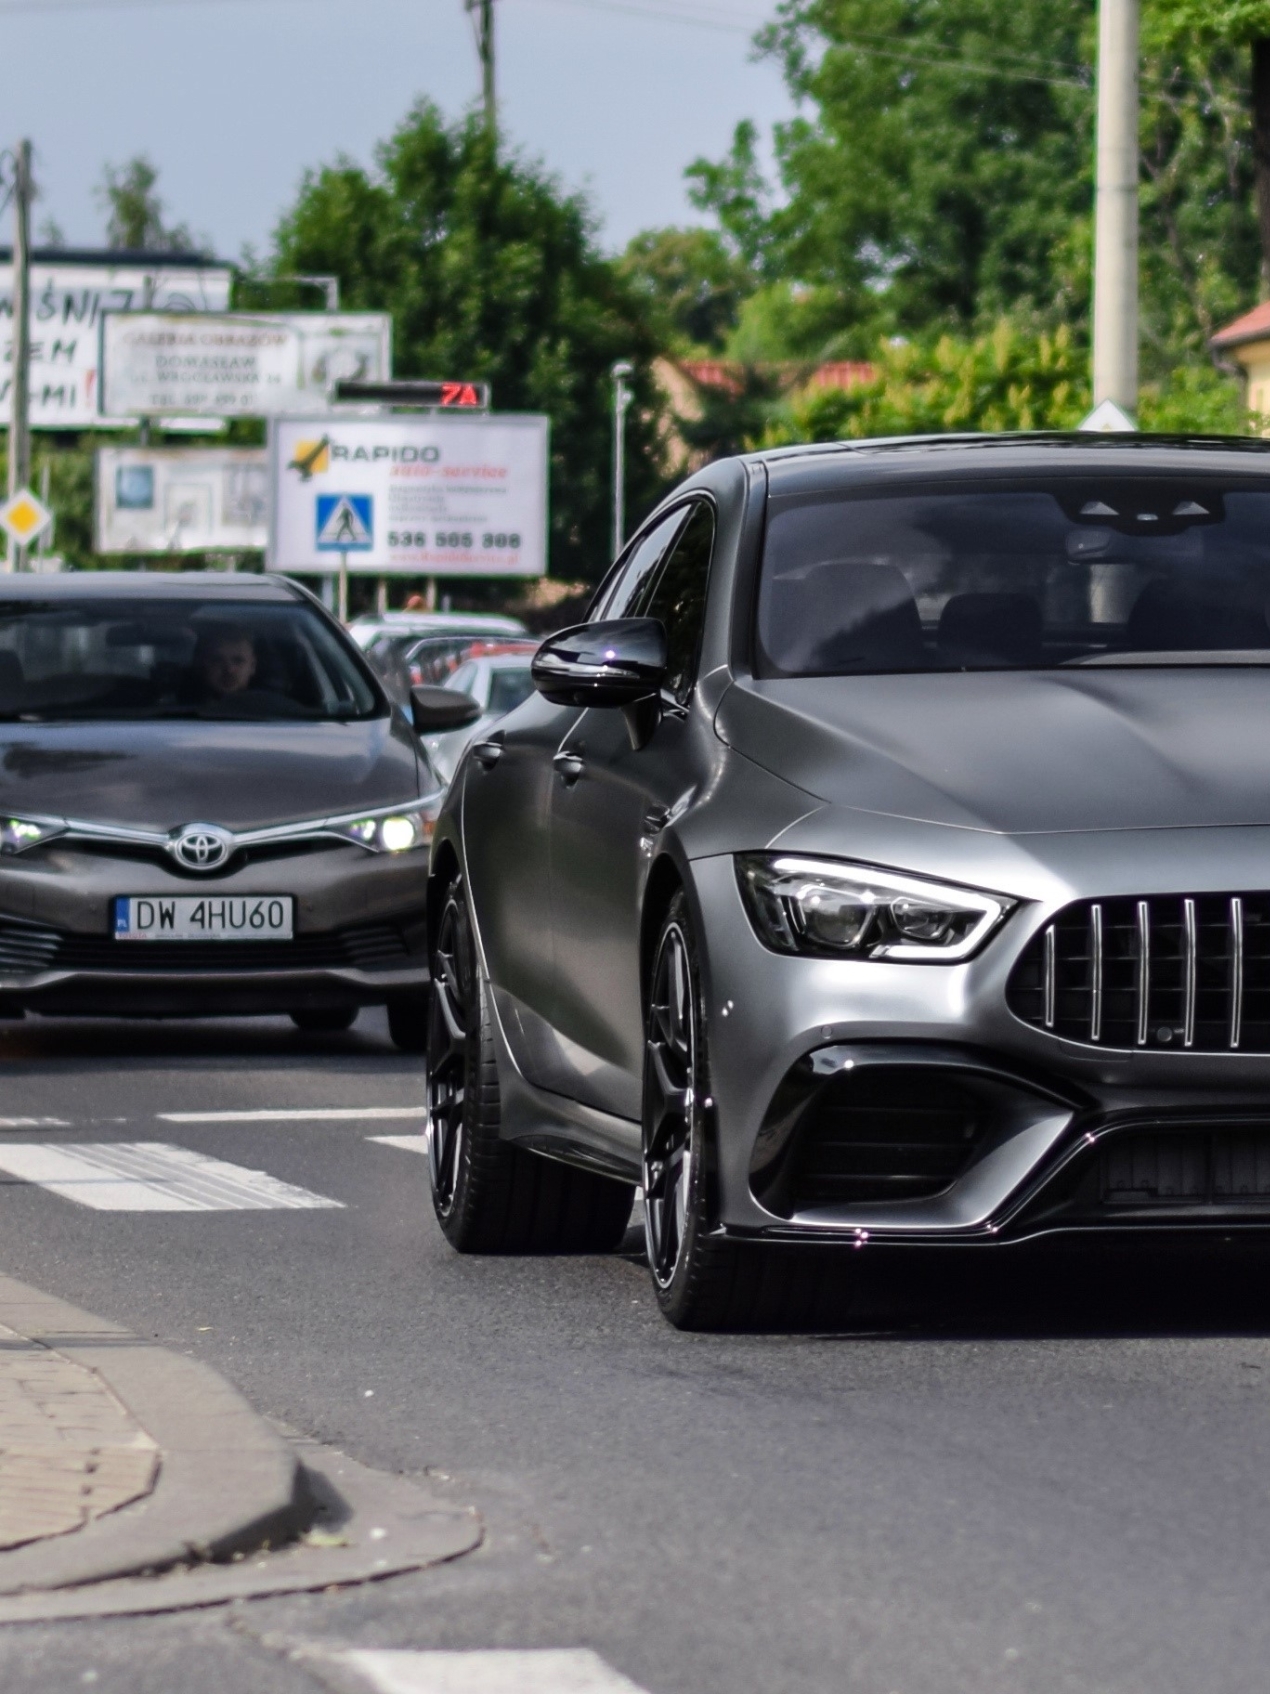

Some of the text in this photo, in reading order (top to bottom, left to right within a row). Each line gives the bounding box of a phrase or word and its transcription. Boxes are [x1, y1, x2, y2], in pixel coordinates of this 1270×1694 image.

[330, 445, 440, 463] RAPIDO
[137, 901, 284, 930] DW 4HU60
